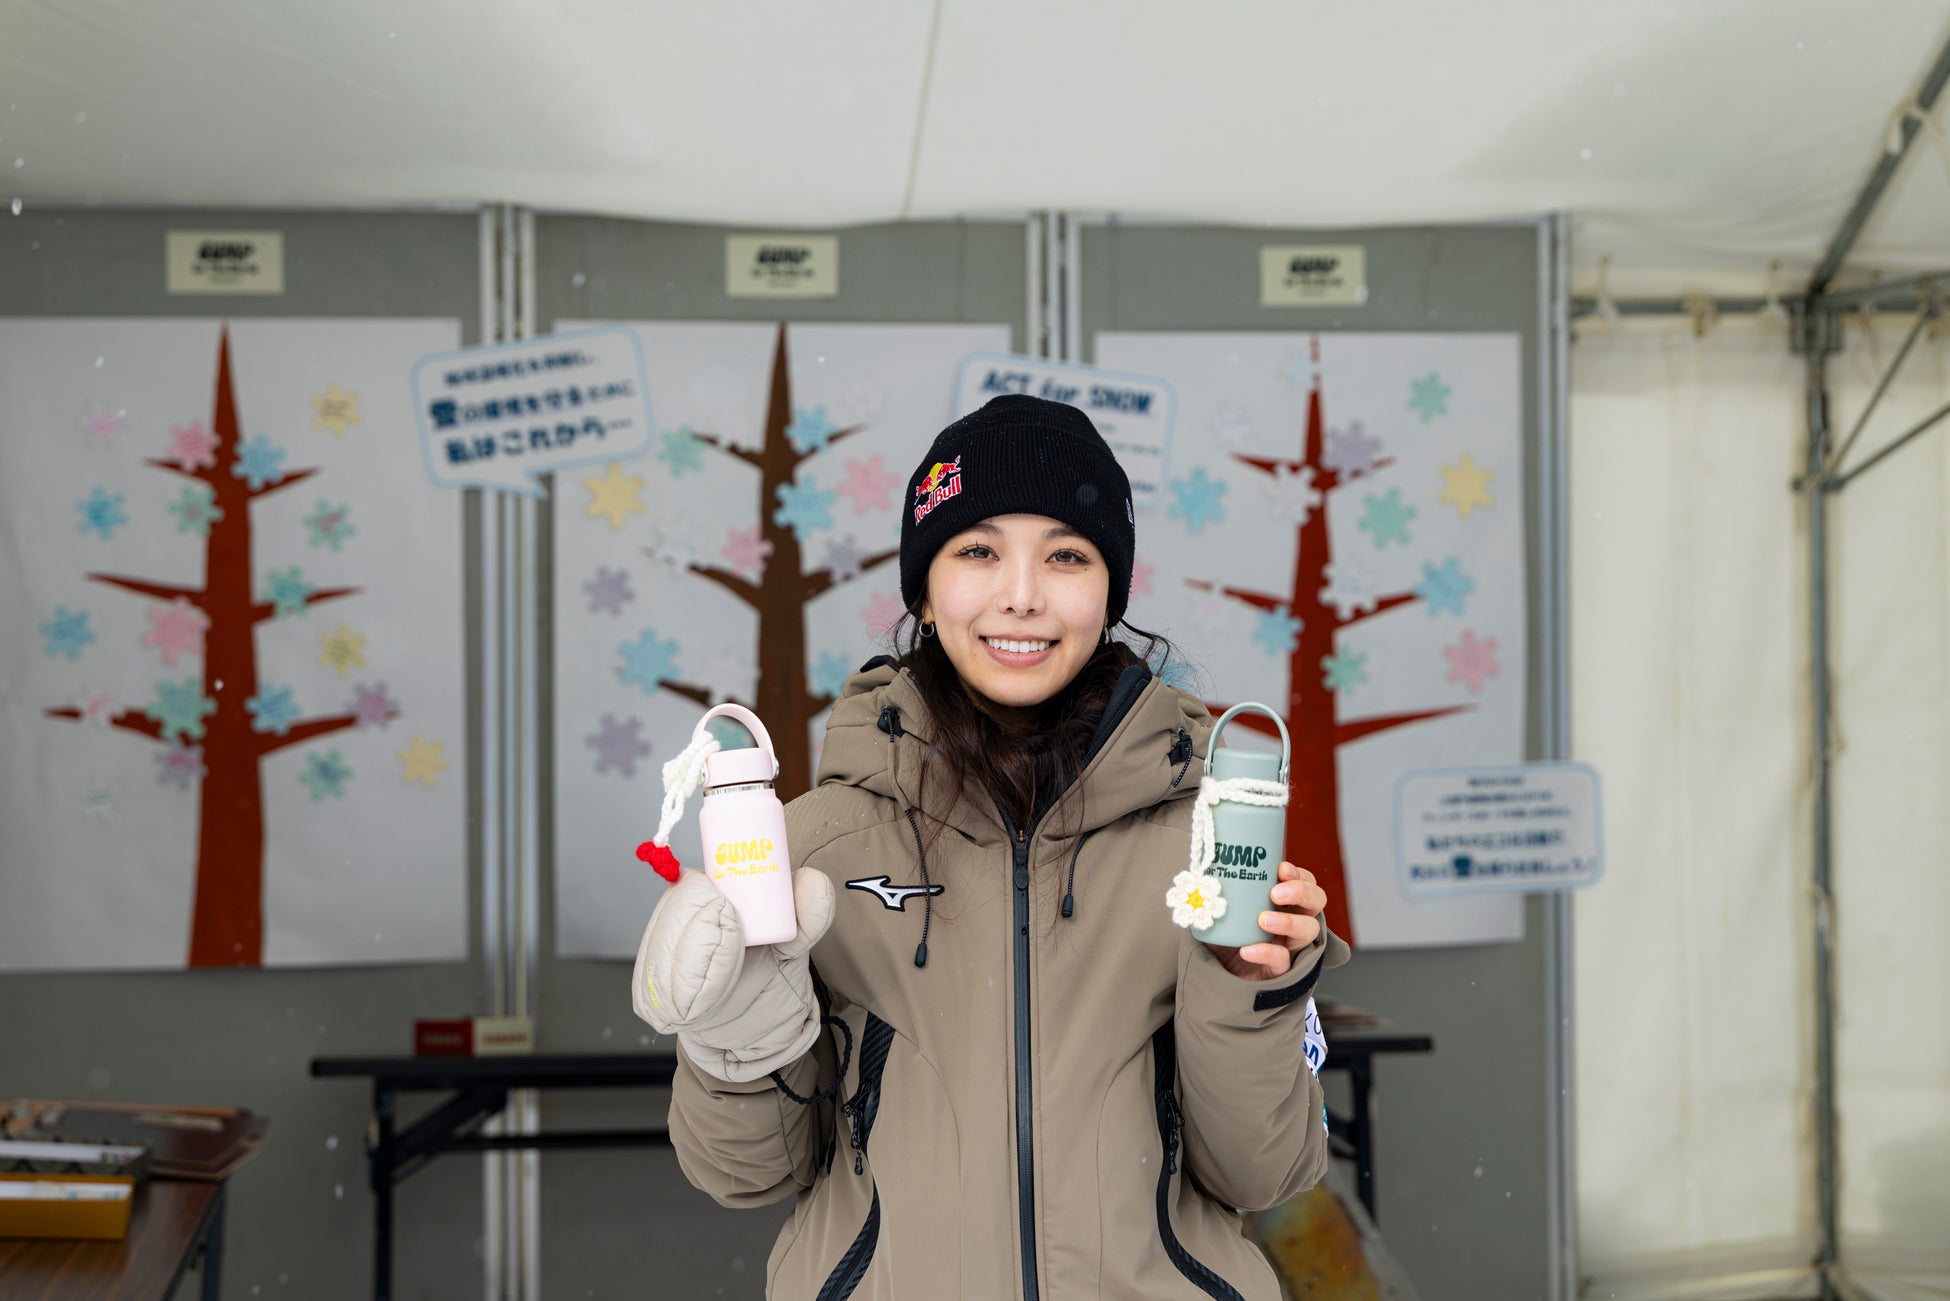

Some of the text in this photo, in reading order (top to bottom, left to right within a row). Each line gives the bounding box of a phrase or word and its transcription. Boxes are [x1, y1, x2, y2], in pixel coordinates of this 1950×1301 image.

[982, 369, 1031, 396] ACT
[1089, 383, 1155, 414] SNOW
[914, 473, 962, 527] Red Bull
[716, 838, 773, 865] JUMP
[1211, 842, 1267, 868] JUMP
[727, 867, 748, 877] The
[749, 862, 778, 874] Earth
[1217, 866, 1238, 879] The
[1239, 869, 1268, 881] Earth
